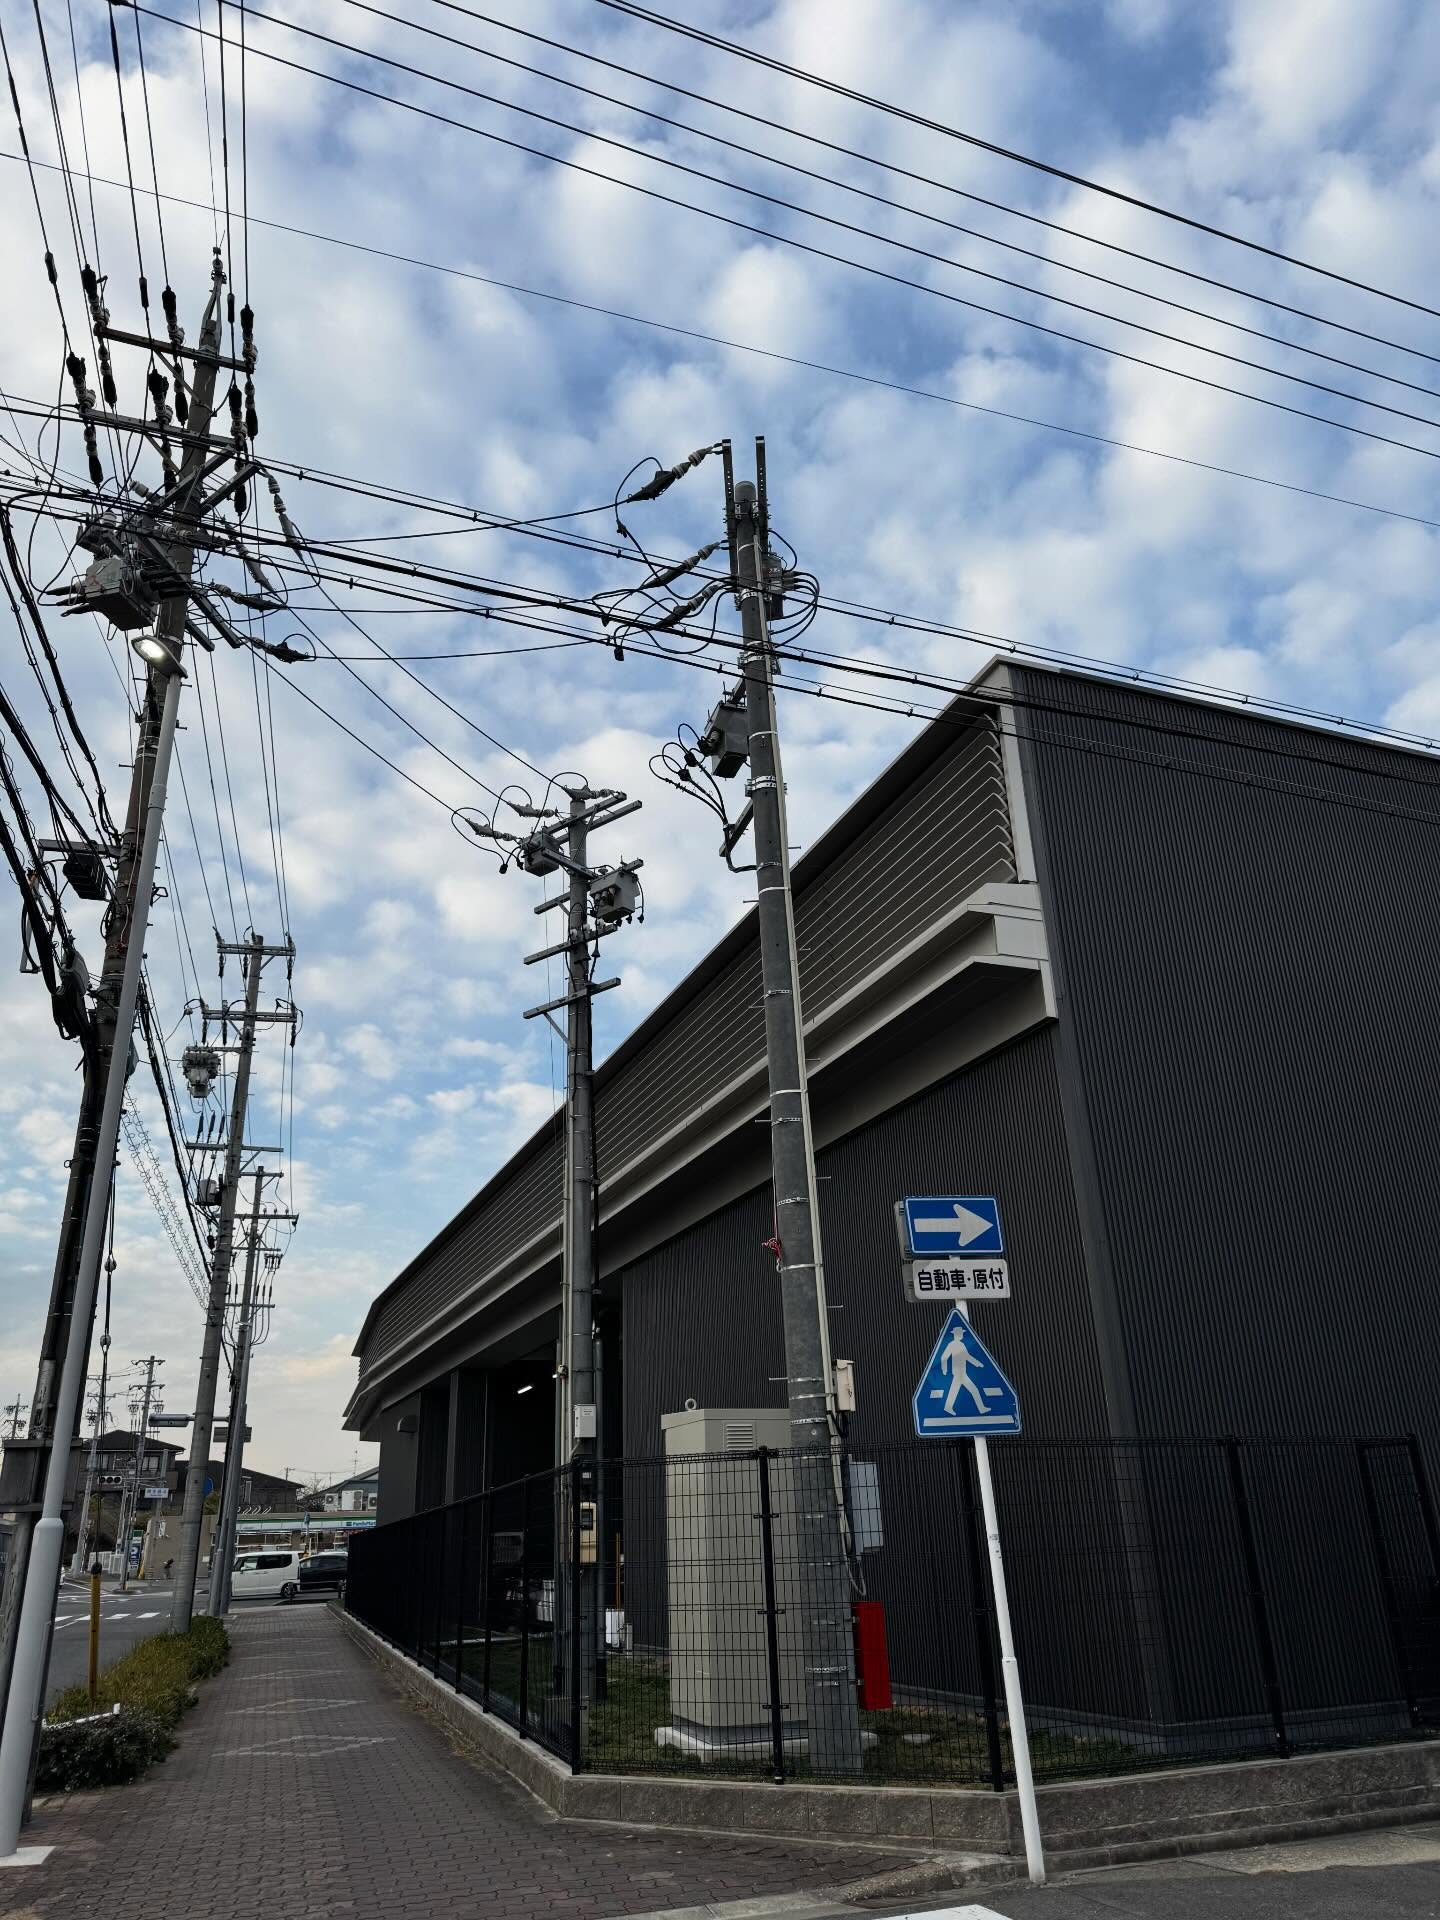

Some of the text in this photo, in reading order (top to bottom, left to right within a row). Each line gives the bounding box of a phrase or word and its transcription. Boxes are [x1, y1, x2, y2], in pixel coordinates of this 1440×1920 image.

[918, 1268, 1004, 1291] 自動車・原付
